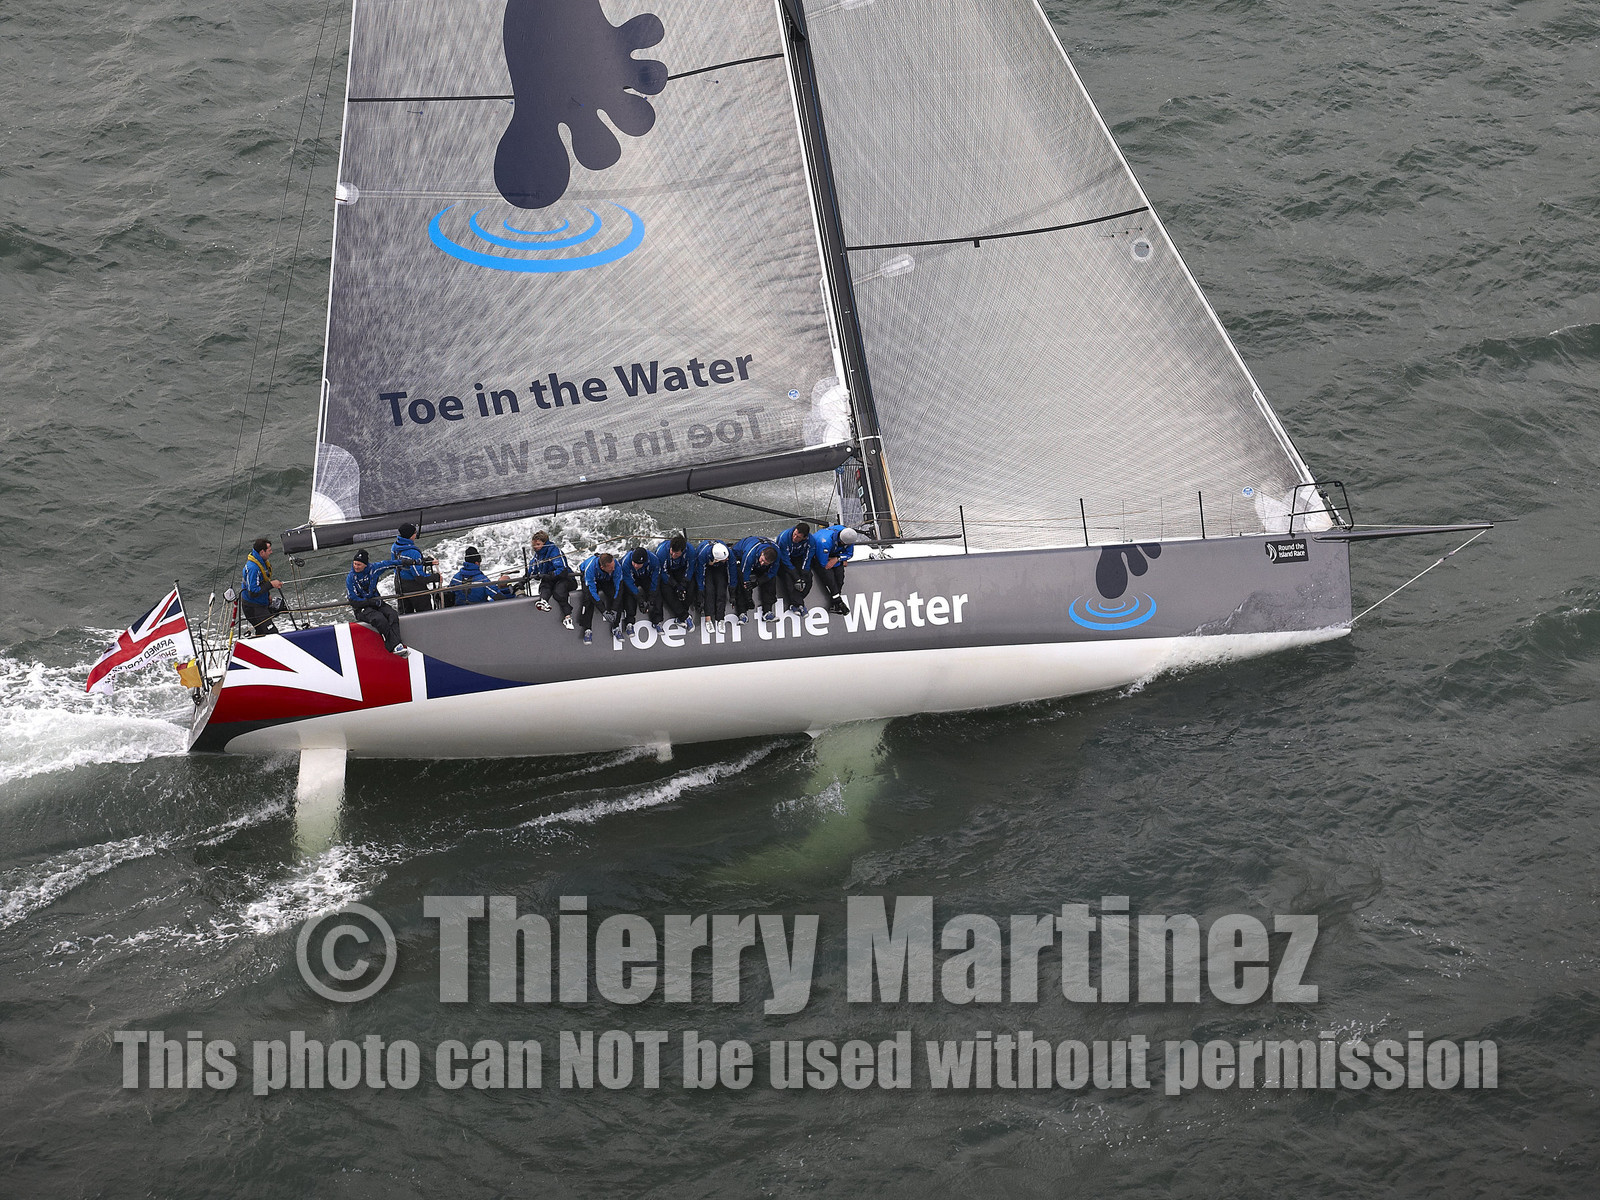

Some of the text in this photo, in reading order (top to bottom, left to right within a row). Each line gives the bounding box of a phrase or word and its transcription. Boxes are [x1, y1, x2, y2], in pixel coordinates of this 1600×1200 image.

[379, 354, 753, 427] Toe in the Water
[1277, 542, 1305, 551] Round the
[753, 597, 830, 640] the
[840, 591, 969, 633] Water
